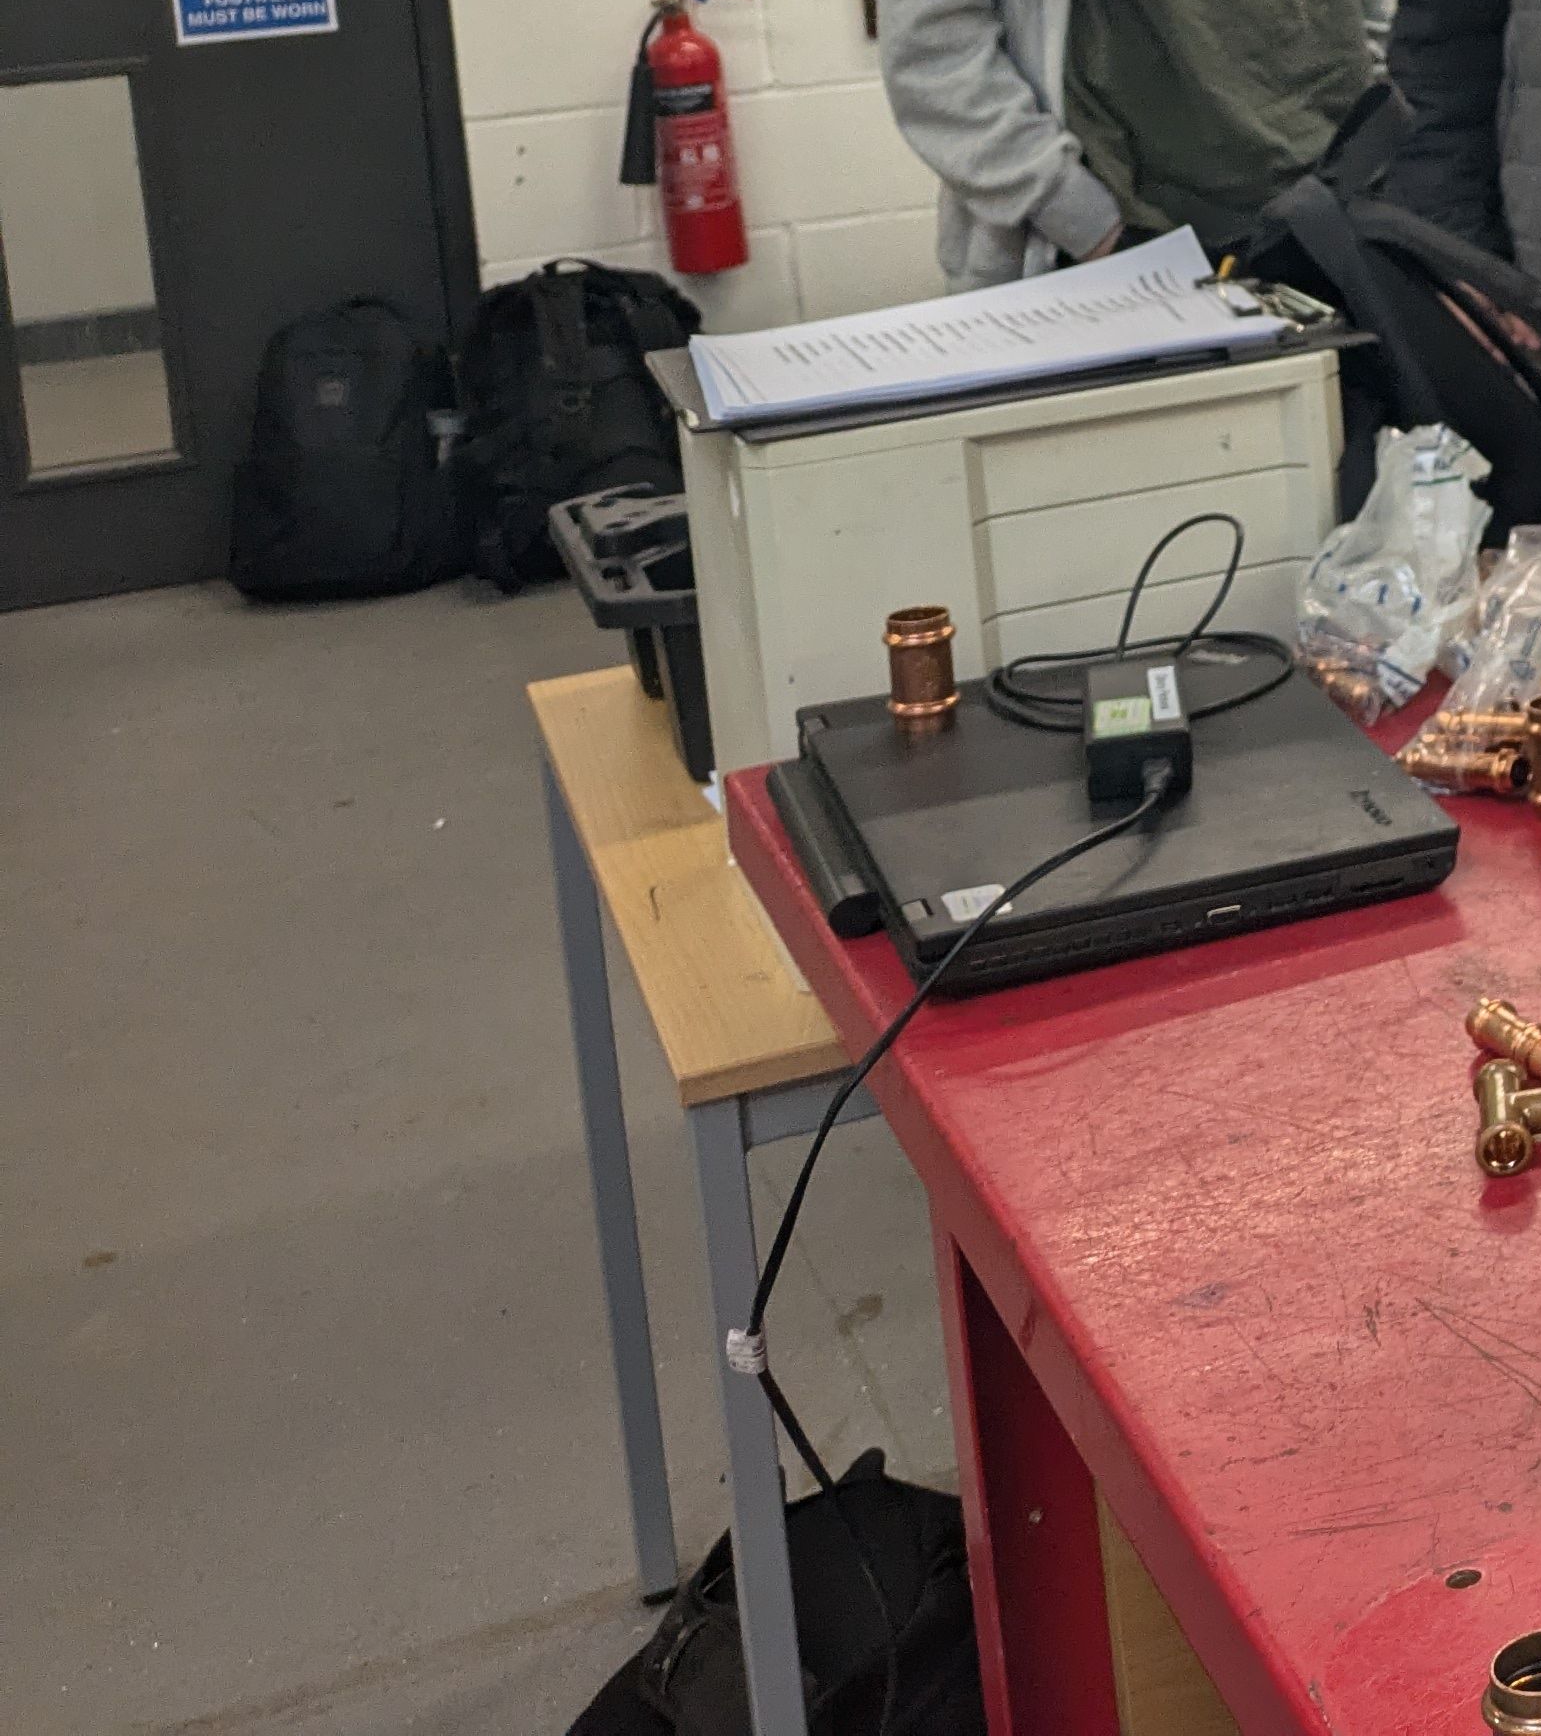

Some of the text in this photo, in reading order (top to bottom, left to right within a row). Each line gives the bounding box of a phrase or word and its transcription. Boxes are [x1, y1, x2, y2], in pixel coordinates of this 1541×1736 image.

[187, 1, 327, 27] MUST BE WORN
